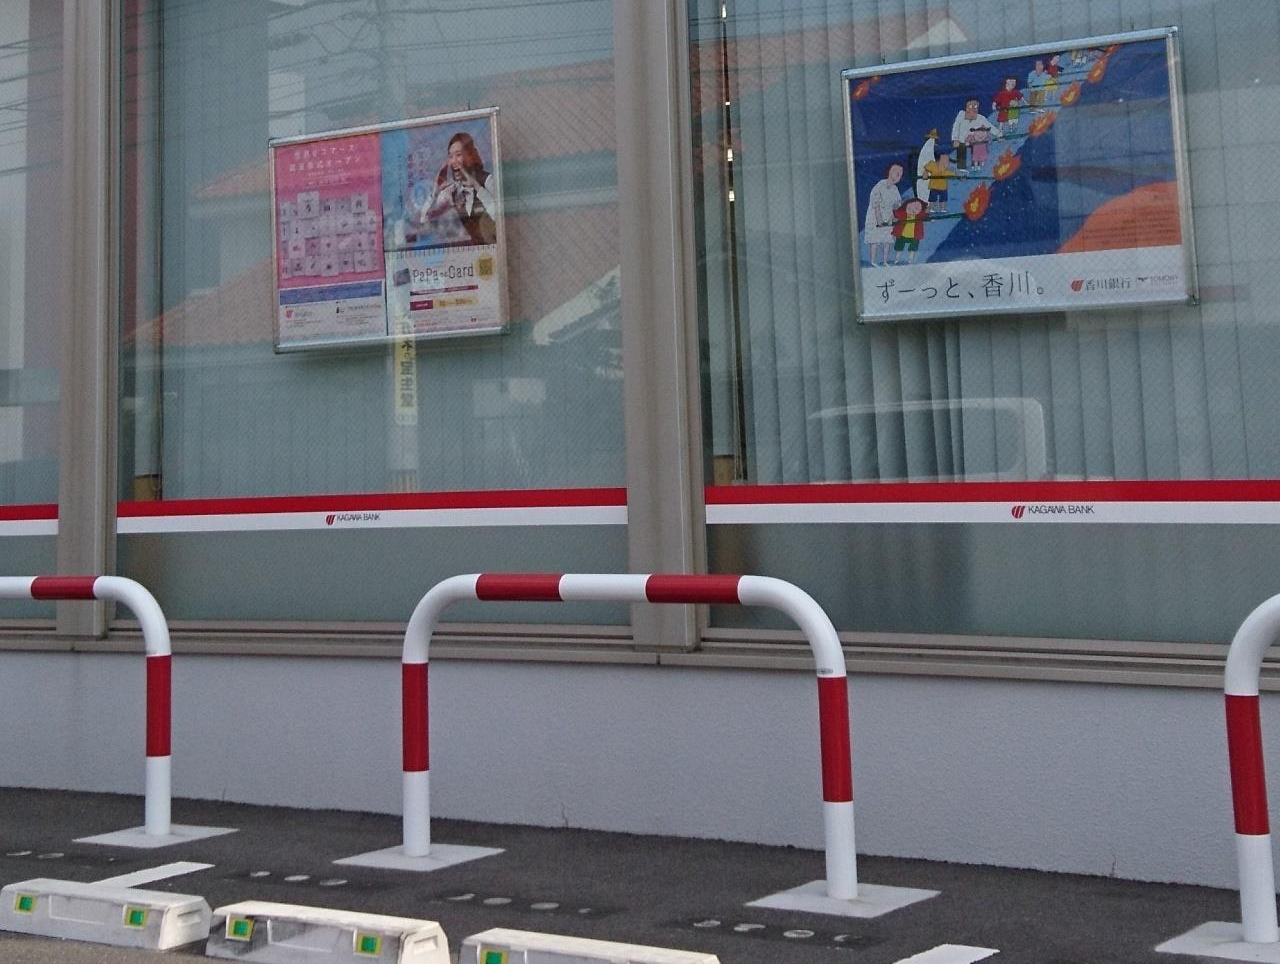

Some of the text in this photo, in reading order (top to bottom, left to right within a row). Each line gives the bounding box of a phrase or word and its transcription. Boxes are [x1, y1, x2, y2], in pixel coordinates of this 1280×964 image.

[448, 263, 474, 279] Card
[876, 271, 1044, 303] ずーっと、香川。
[1086, 276, 1132, 291] 香川銀行
[363, 512, 380, 521] BANK
[1028, 505, 1094, 514] KAGAWA BANK
